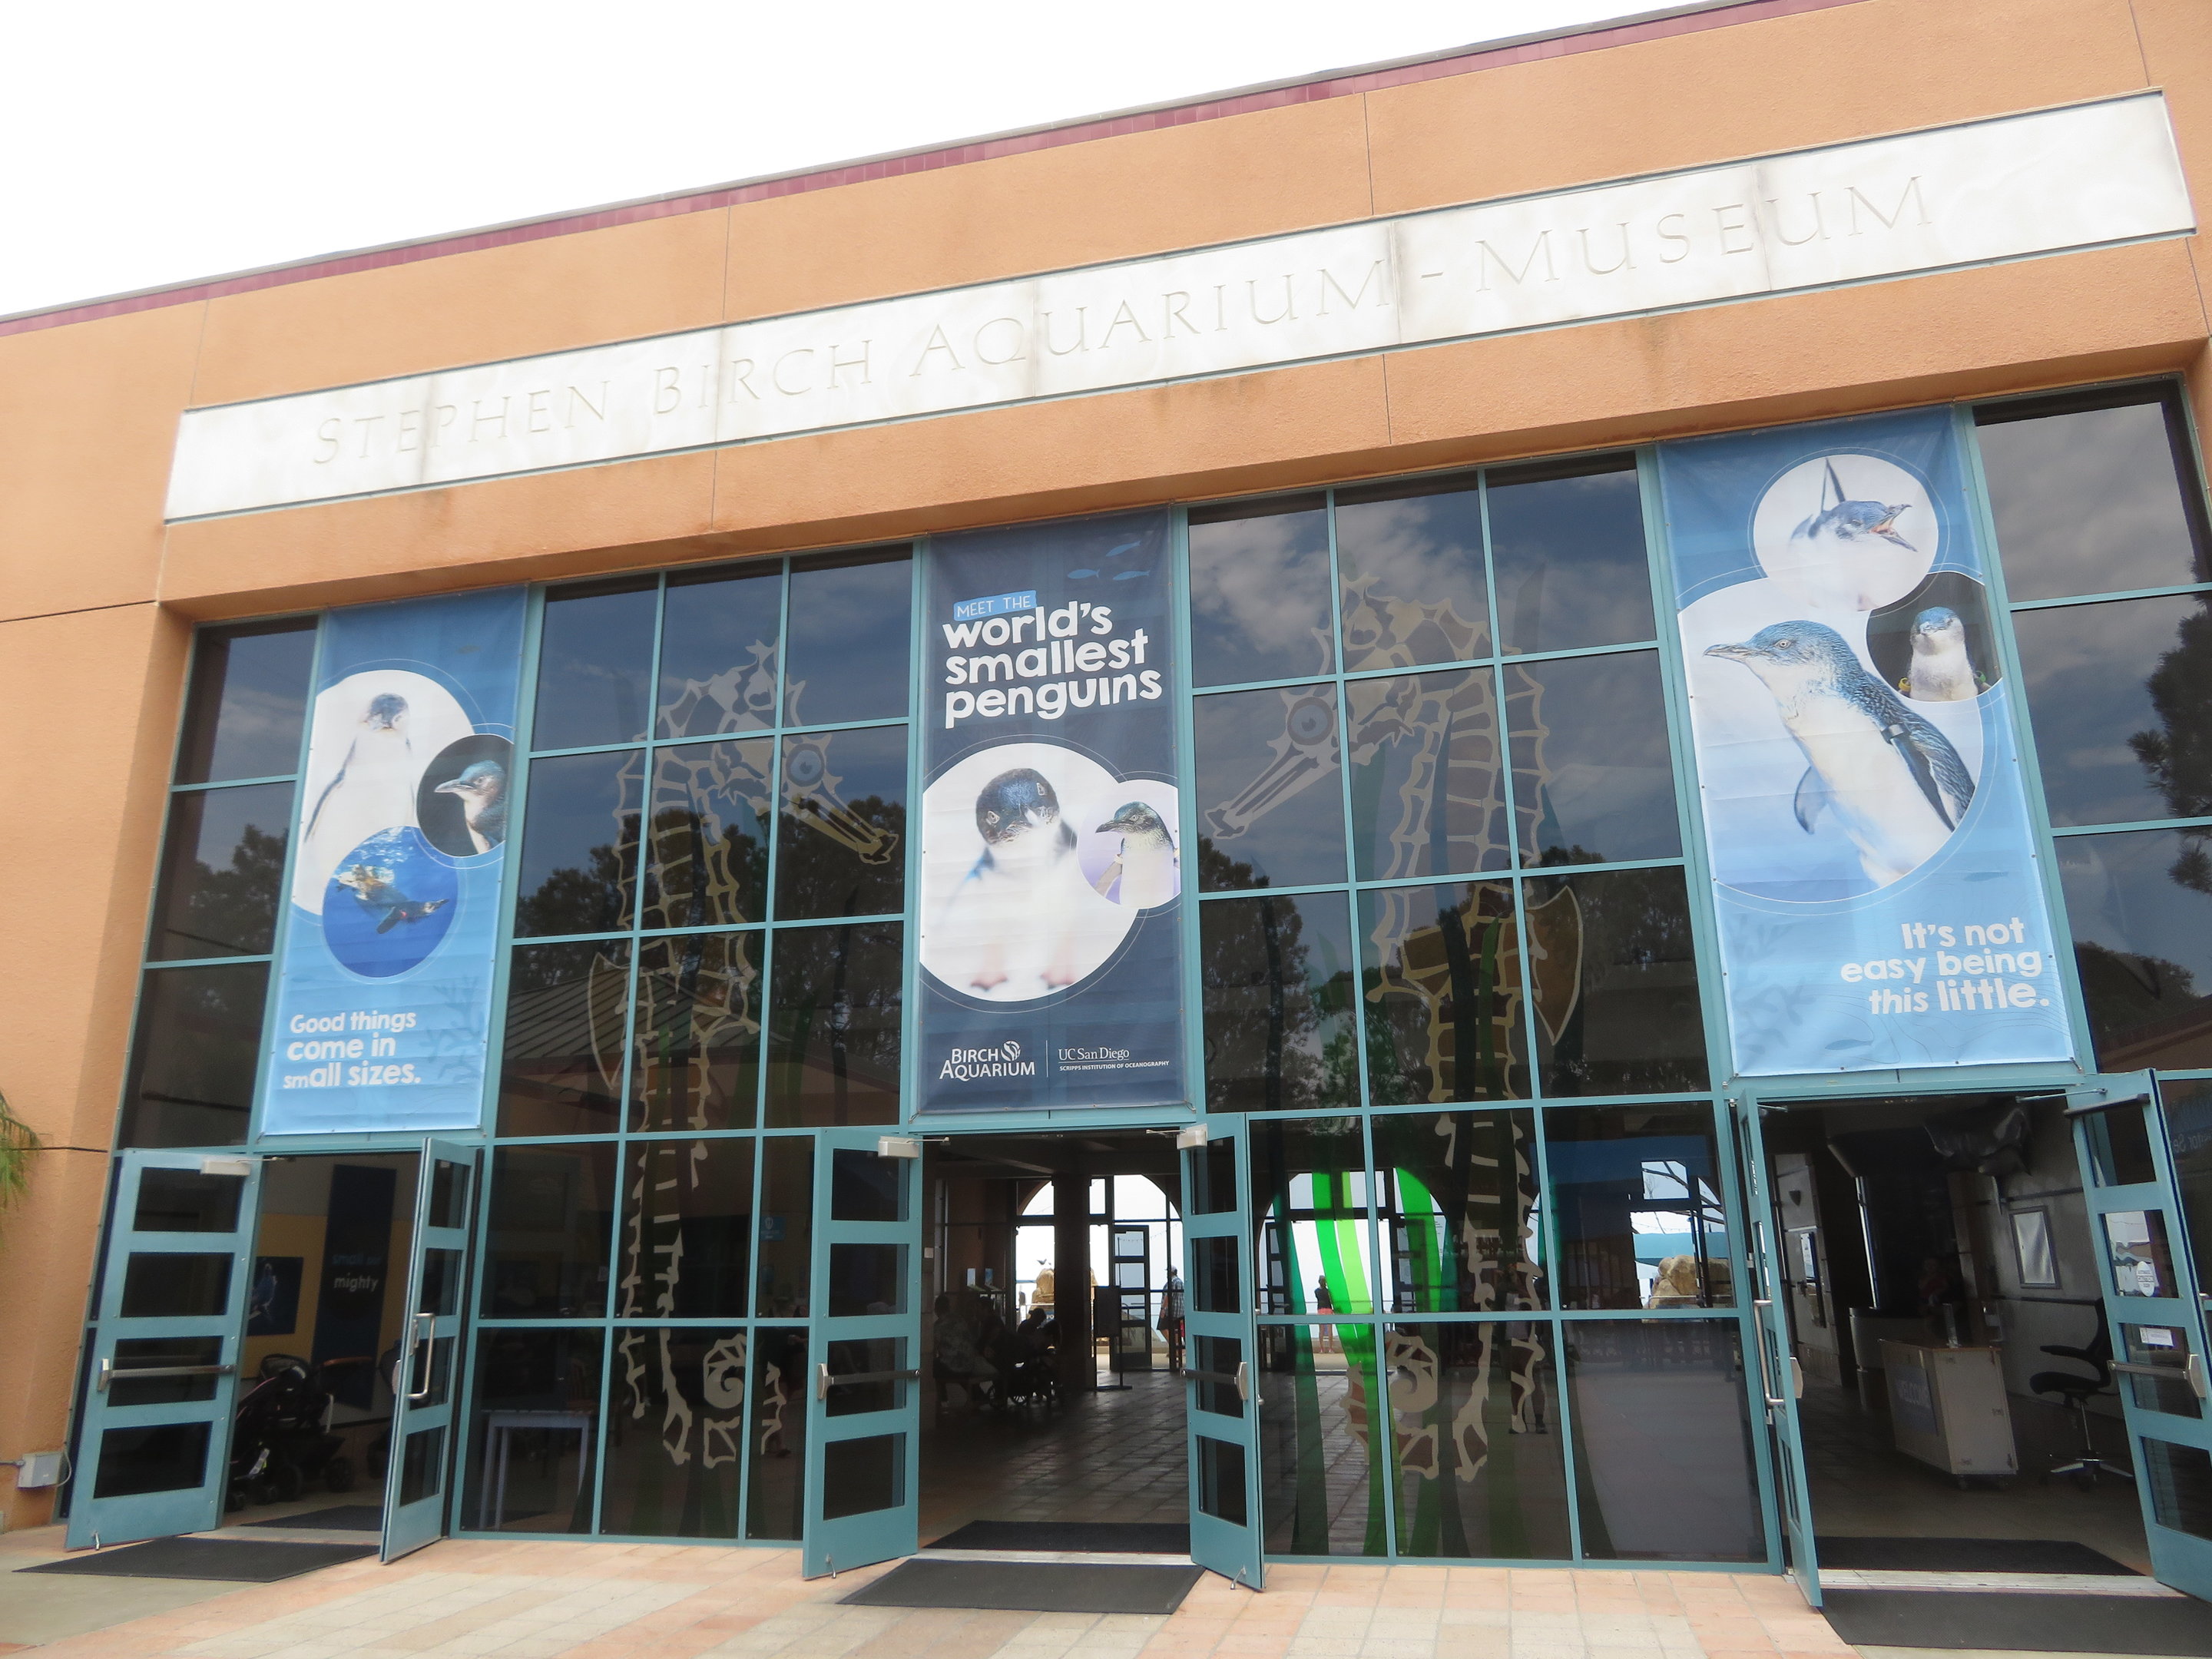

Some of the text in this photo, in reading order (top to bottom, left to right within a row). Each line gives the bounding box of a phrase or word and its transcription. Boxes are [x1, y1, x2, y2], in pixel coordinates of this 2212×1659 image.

[313, 379, 611, 464] STEPHEN
[653, 339, 873, 416] BIRCH
[909, 258, 1390, 378] AQUARIUM
[1474, 175, 1932, 292] MUSEUM
[956, 594, 1031, 618] MEET THE
[942, 601, 1113, 649] world's
[945, 628, 1149, 685] smallest
[945, 670, 1163, 730] penguins
[1901, 917, 2025, 949] It's not
[1840, 948, 2042, 984] easy being
[1869, 978, 2050, 1015] this little.
[290, 1010, 417, 1034] Good things
[286, 1031, 396, 1061] come in
[952, 1047, 998, 1065] BIRCH
[1058, 1047, 1130, 1061] UC San Diego
[283, 1060, 422, 1089] small sizes.
[939, 1060, 1035, 1082] AQUARIUM
[1124, 1060, 1170, 1068] OCEANOGRAPHY
[333, 1271, 379, 1292] mighty
